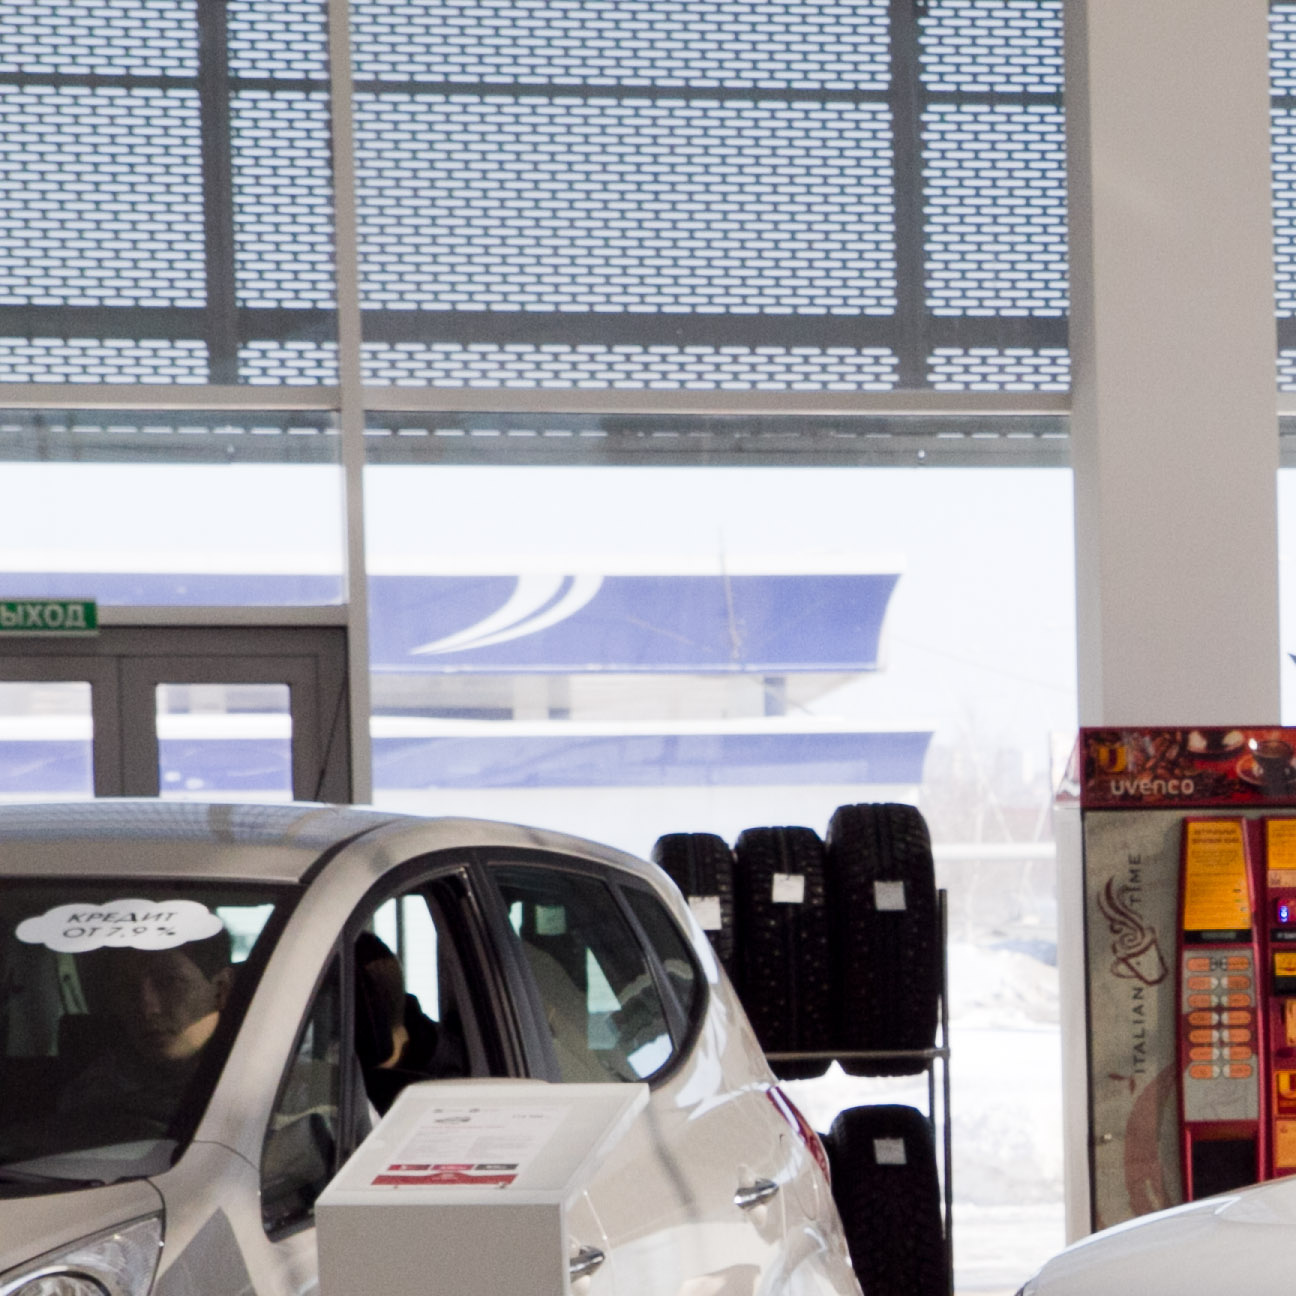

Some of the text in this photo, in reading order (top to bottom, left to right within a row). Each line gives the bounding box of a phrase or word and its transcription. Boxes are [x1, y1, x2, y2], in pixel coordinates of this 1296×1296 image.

[1110, 779, 1195, 796] uvenco
[67, 912, 177, 923] КРЕДИТ
[63, 927, 101, 938] ОТ
[1128, 854, 1146, 1073] ITALIAN TIME
